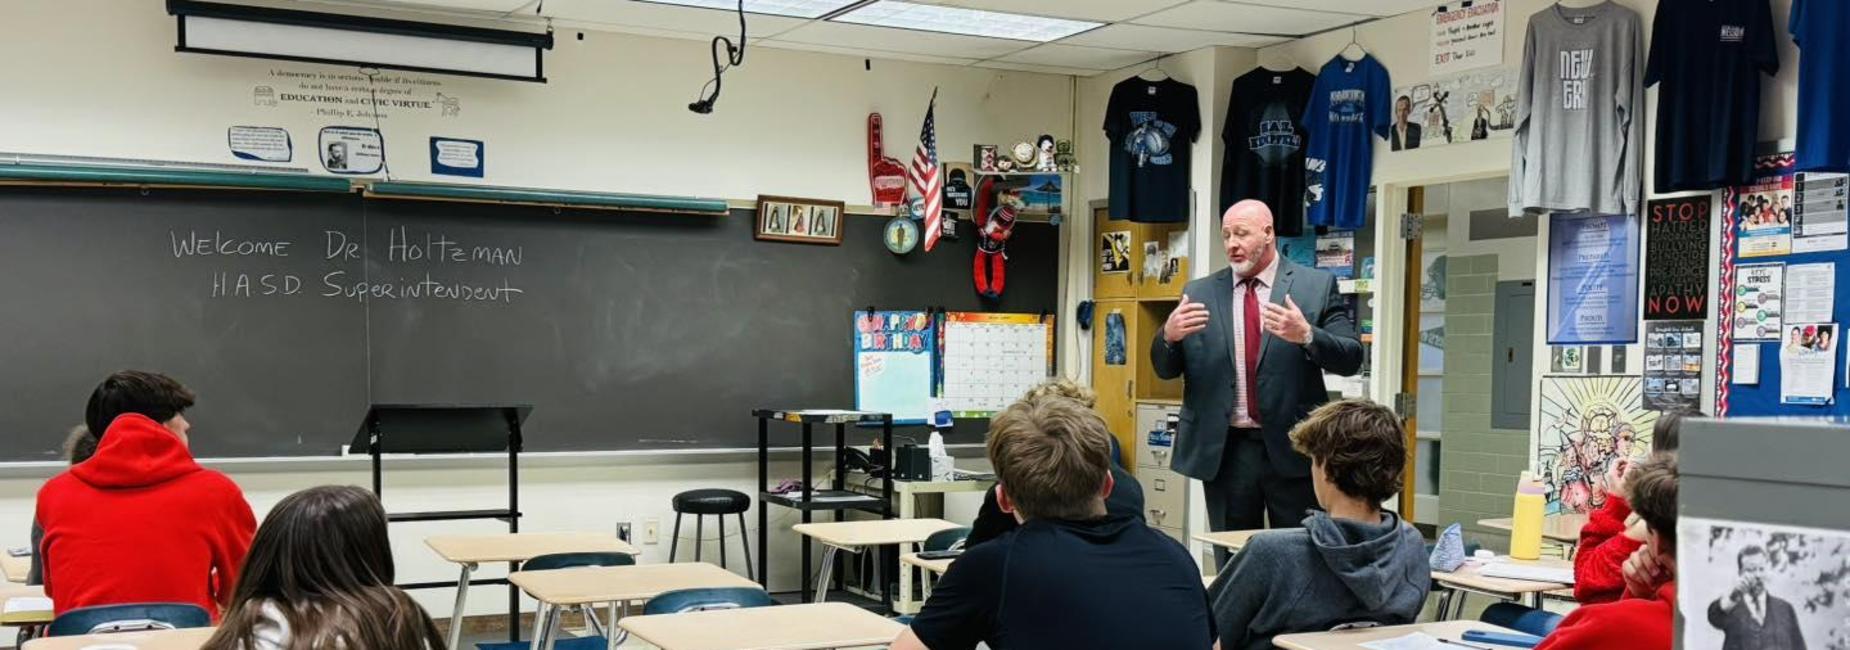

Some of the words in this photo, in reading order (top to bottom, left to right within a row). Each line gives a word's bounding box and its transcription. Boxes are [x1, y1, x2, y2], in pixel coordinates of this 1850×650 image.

[1560, 49, 1594, 79] NEW
[280, 93, 343, 103] EDUCATION
[955, 198, 968, 206] YOU
[1652, 202, 1708, 223] STOP
[1651, 219, 1708, 234] HATRED
[1649, 283, 1705, 297] APATHY
[1648, 296, 1705, 314] NOW
[861, 331, 927, 350] BIRTHDAY
